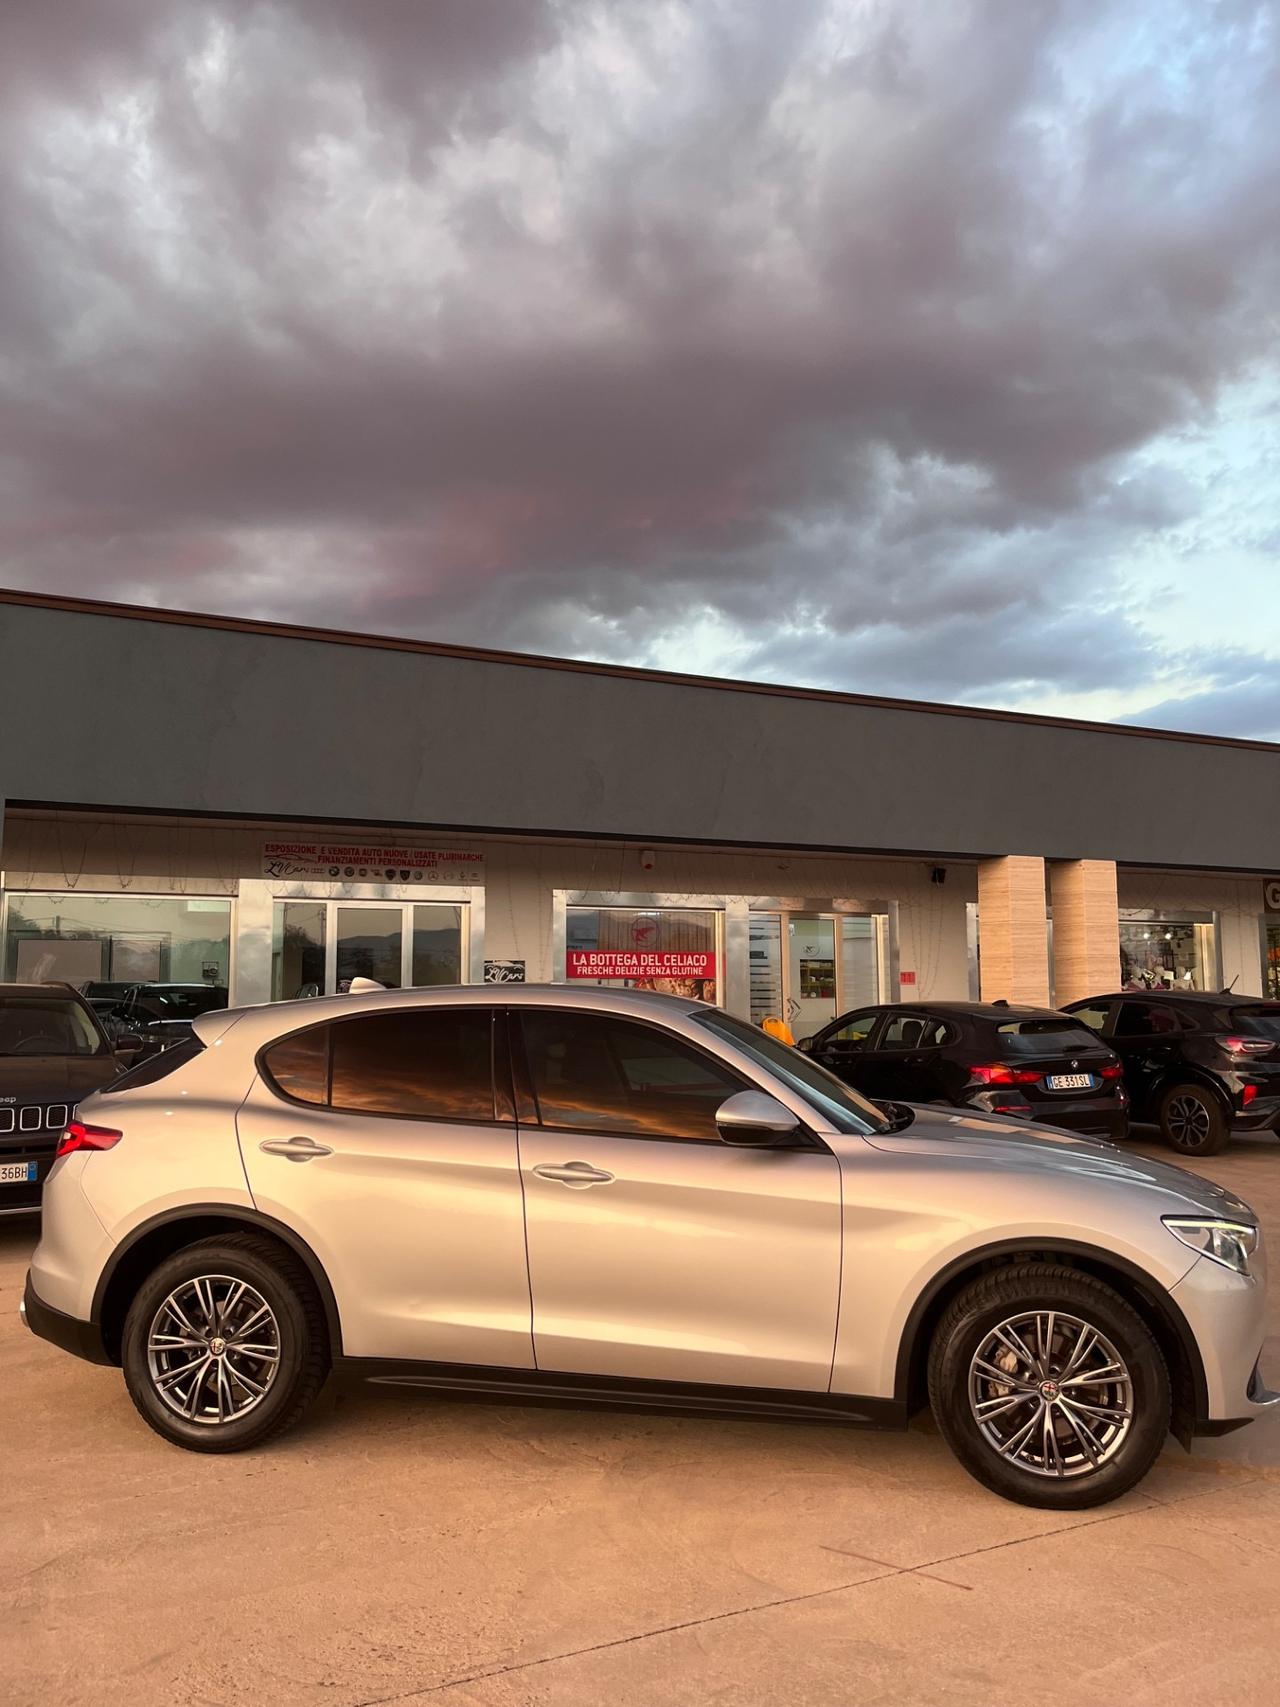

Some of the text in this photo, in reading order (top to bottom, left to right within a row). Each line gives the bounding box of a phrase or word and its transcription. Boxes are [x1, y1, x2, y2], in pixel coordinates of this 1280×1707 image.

[265, 844, 316, 854] ESPOSIZIONE
[321, 846, 326, 854] E
[327, 847, 360, 856] VENDITA
[362, 848, 382, 857] AUTO
[383, 849, 409, 858] NUOVE
[414, 850, 437, 859] USATE
[317, 855, 438, 867] FINANZIAMENTI PERSONALIZZATI
[573, 953, 707, 967] LA BOTTEGA DEL CELIACO
[577, 966, 704, 975] FRESCHE DELIZIE SENZA GLUTINE
[1053, 1075, 1089, 1087] GE 331SL
[1, 1166, 27, 1179] 36BH
